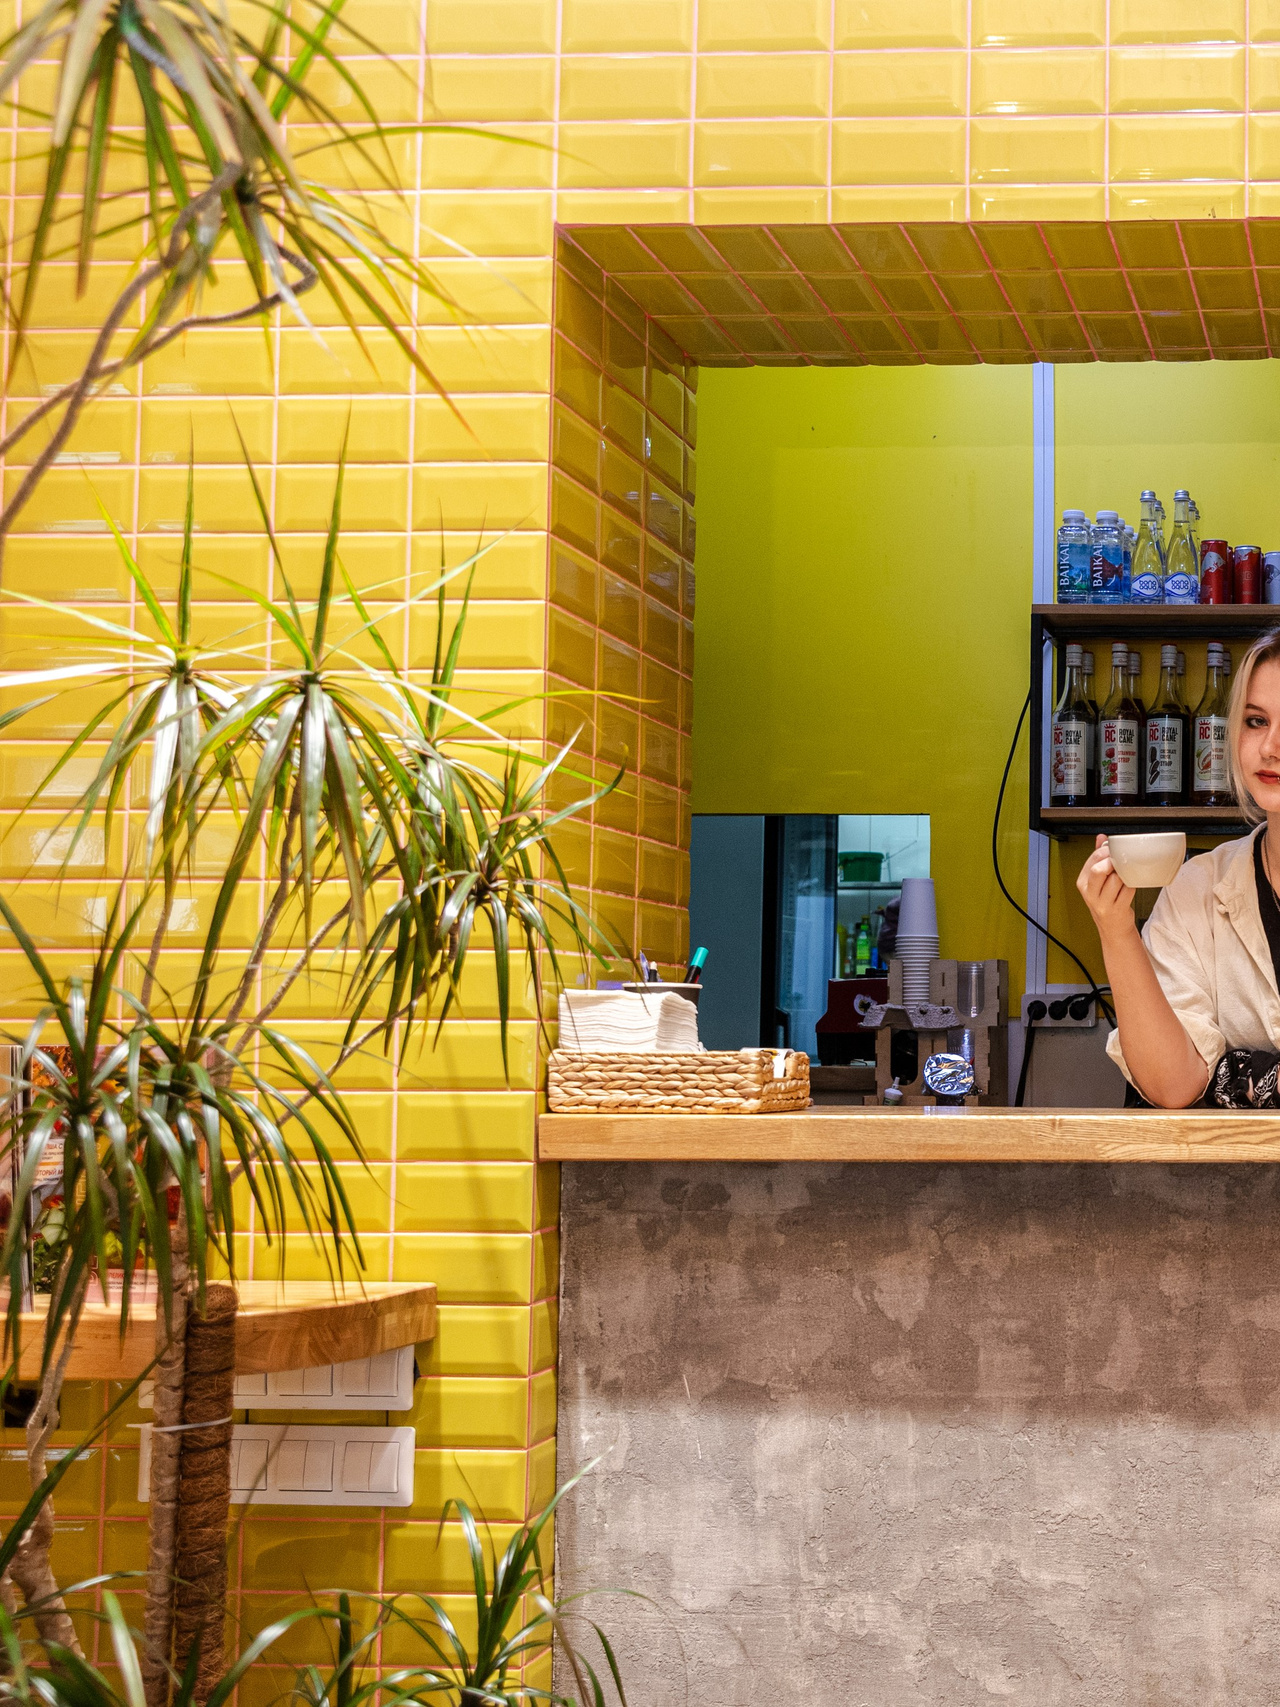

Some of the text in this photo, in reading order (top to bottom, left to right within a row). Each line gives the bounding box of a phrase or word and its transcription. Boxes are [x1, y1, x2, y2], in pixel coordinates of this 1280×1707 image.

[1060, 541, 1070, 586] BAIKAL
[1092, 541, 1102, 587] BAIKAL
[1054, 732, 1062, 745] RC
[1066, 730, 1082, 738] ROYAL
[1105, 730, 1116, 743] RC
[1149, 728, 1159, 742] RC
[1162, 733, 1176, 742] CANE
[1200, 726, 1210, 740] RC
[1066, 737, 1080, 745] CANE
